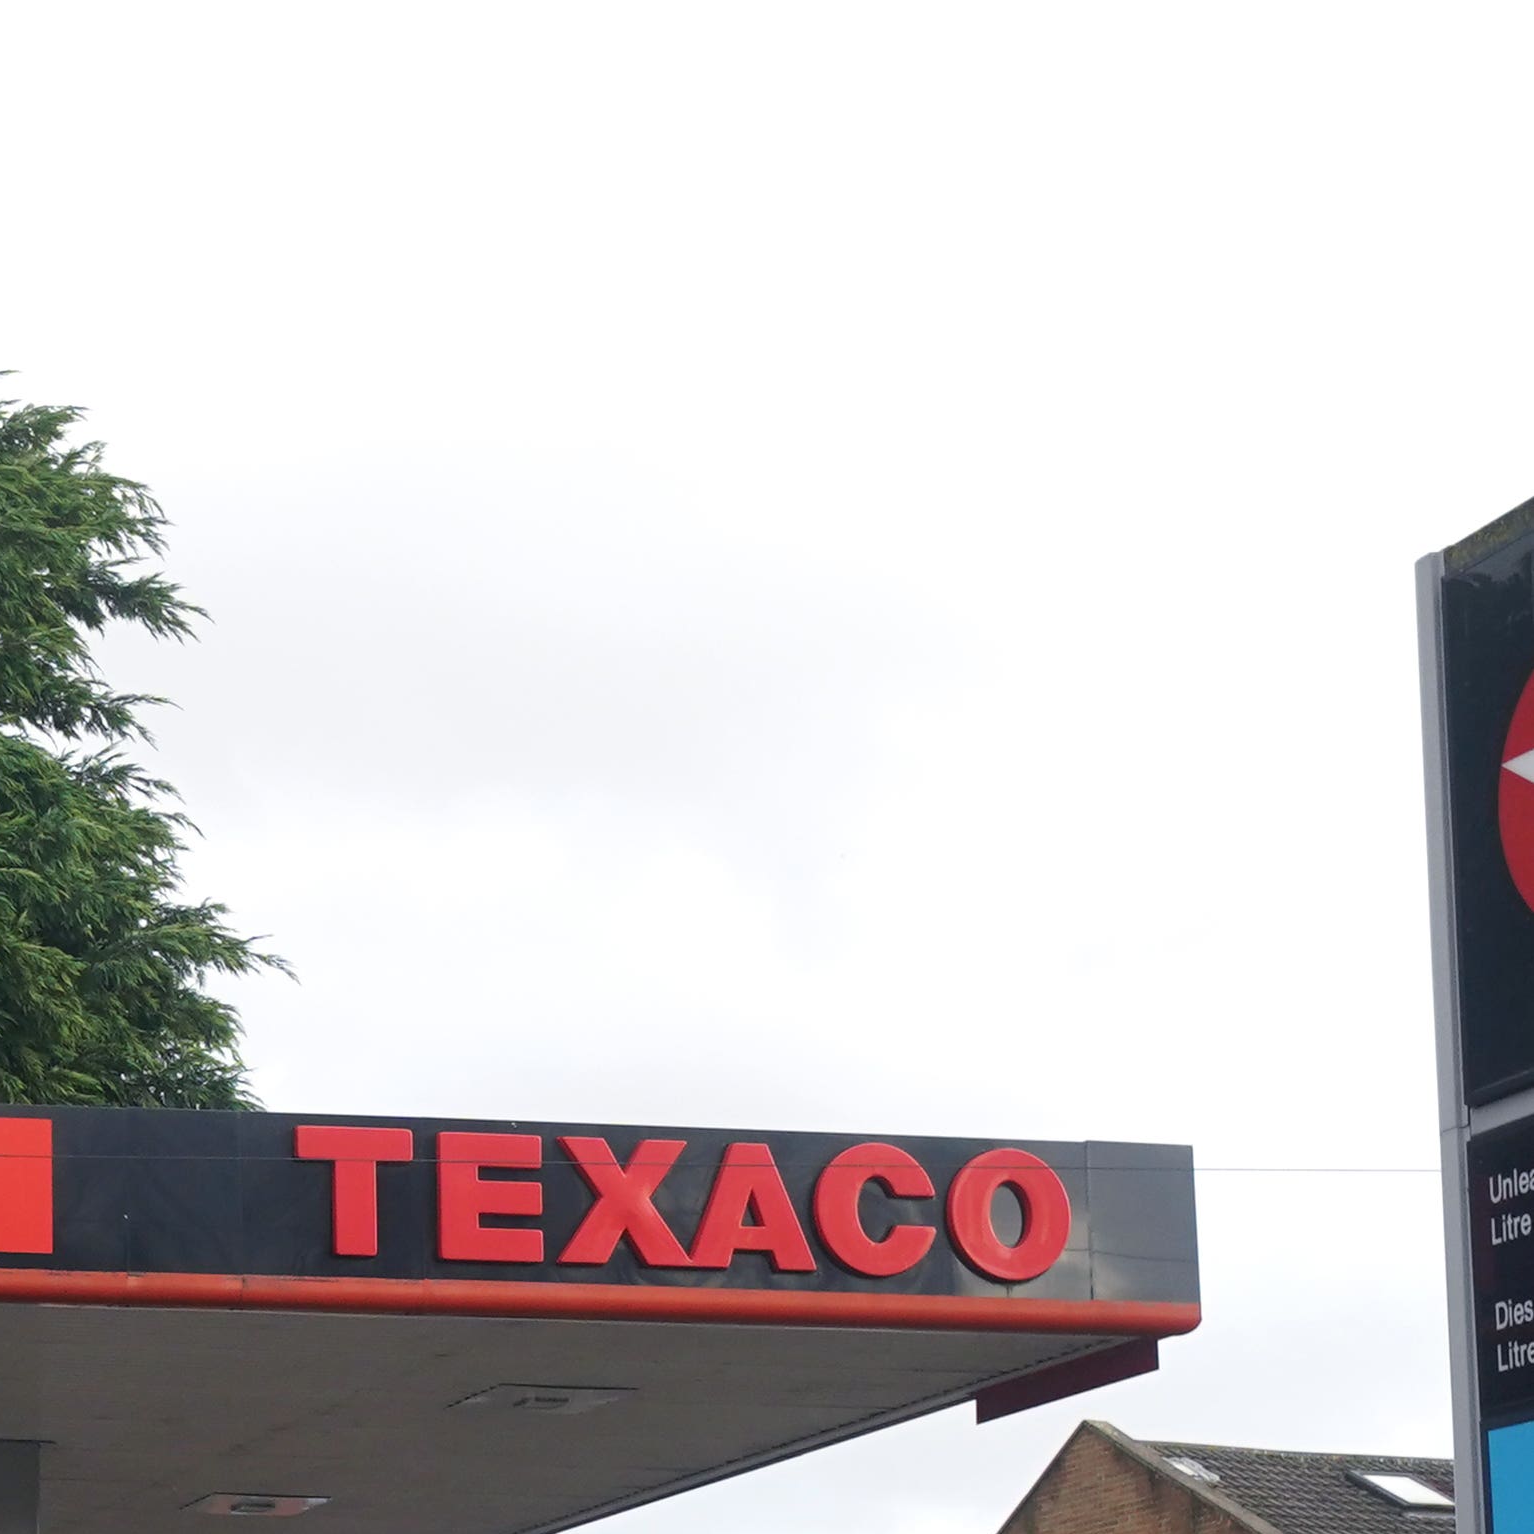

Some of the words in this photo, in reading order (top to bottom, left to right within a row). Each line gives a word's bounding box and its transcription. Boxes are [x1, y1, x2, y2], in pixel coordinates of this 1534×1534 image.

[294, 1125, 1071, 1280] TEXACO
[1491, 1213, 1531, 1246] Litre
[1495, 1299, 1534, 1331] Dies
[1497, 1340, 1534, 1372] Litre
